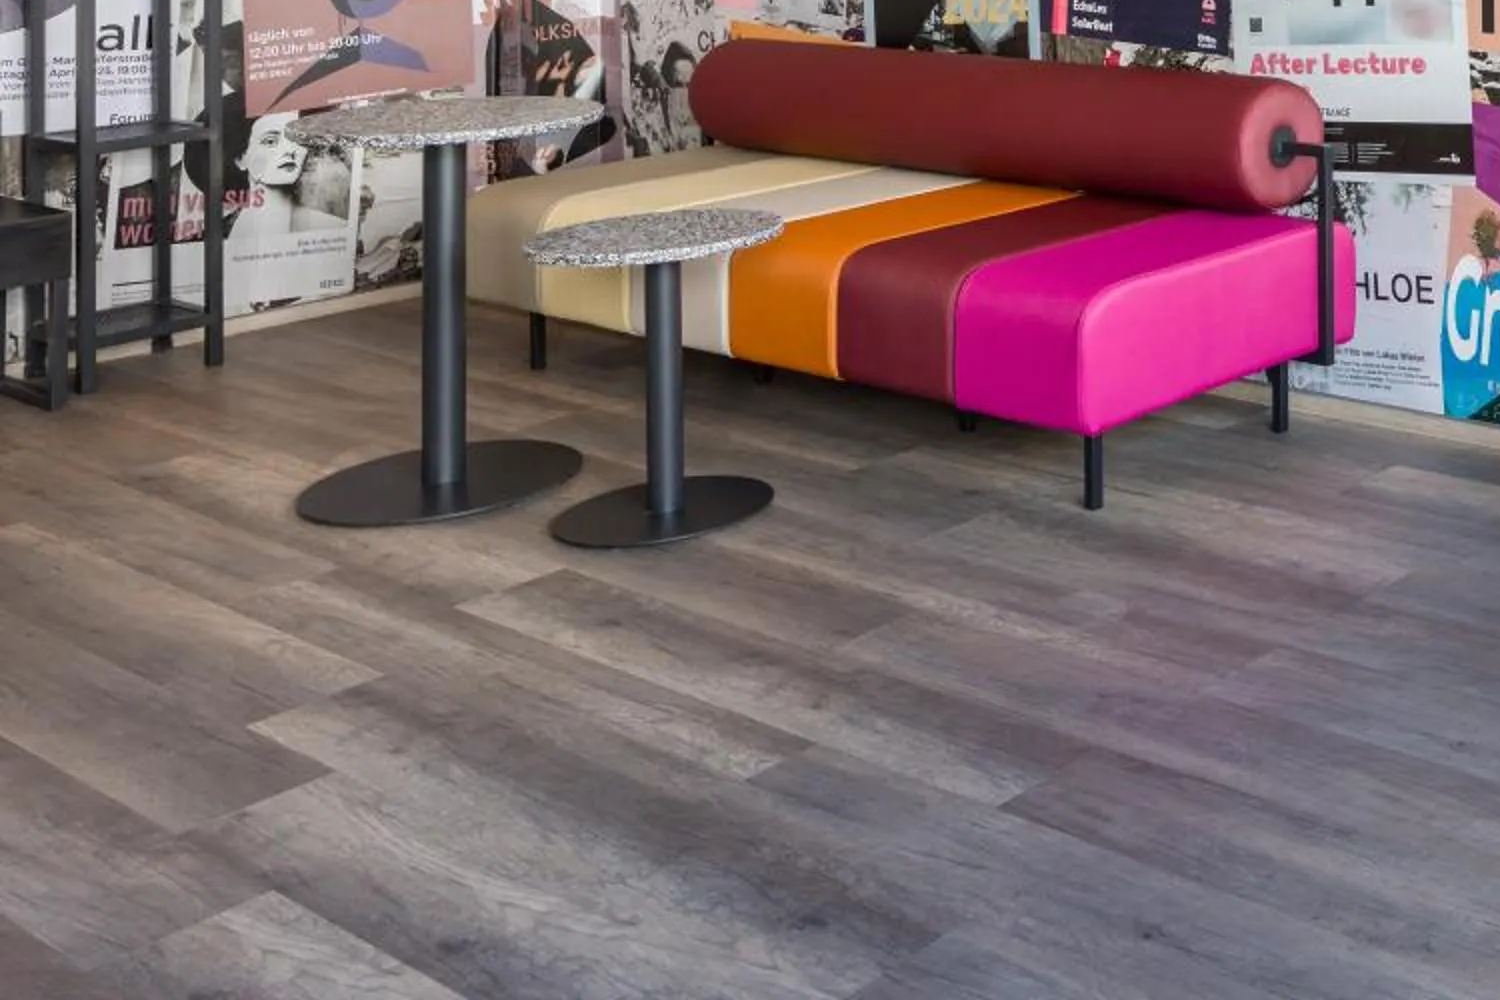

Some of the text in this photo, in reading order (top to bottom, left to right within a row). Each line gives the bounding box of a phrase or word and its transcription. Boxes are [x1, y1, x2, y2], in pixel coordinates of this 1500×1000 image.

[1251, 52, 1426, 75] After Lecture
[1355, 271, 1435, 305] HLOE
